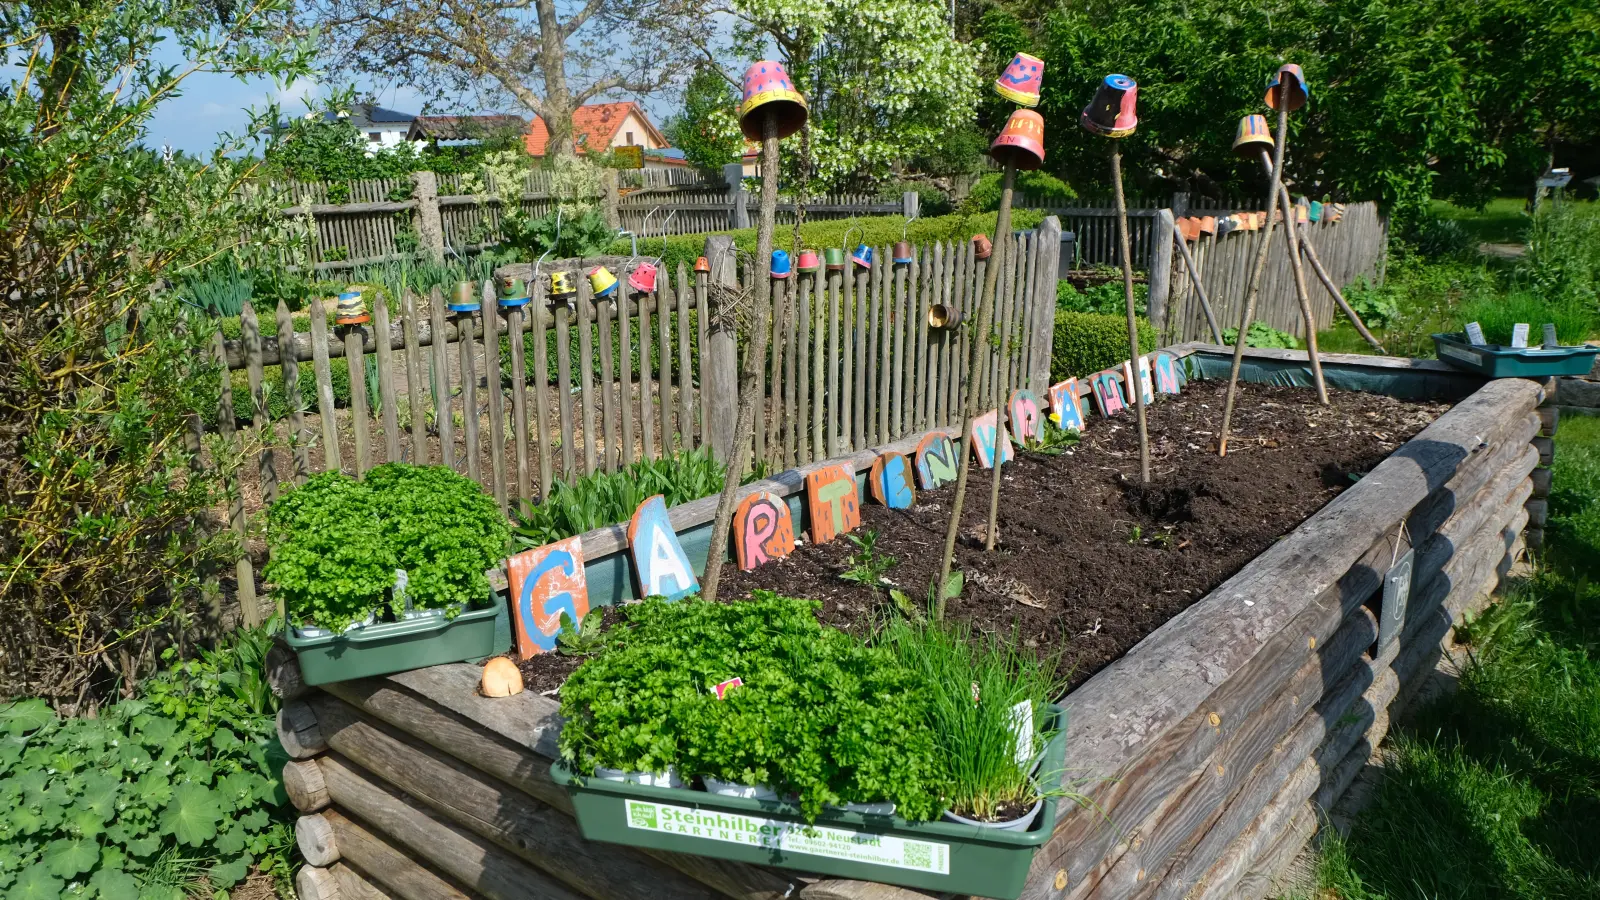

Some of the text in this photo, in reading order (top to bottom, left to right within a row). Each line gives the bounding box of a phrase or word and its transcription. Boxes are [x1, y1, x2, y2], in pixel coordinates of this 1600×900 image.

[661, 807, 781, 836] Steinhilber
[664, 823, 781, 846] GÄRTNEREI
[787, 826, 882, 847] 920 Neustadt
[788, 843, 900, 865] www.gaertnerei-steinhilber.de
